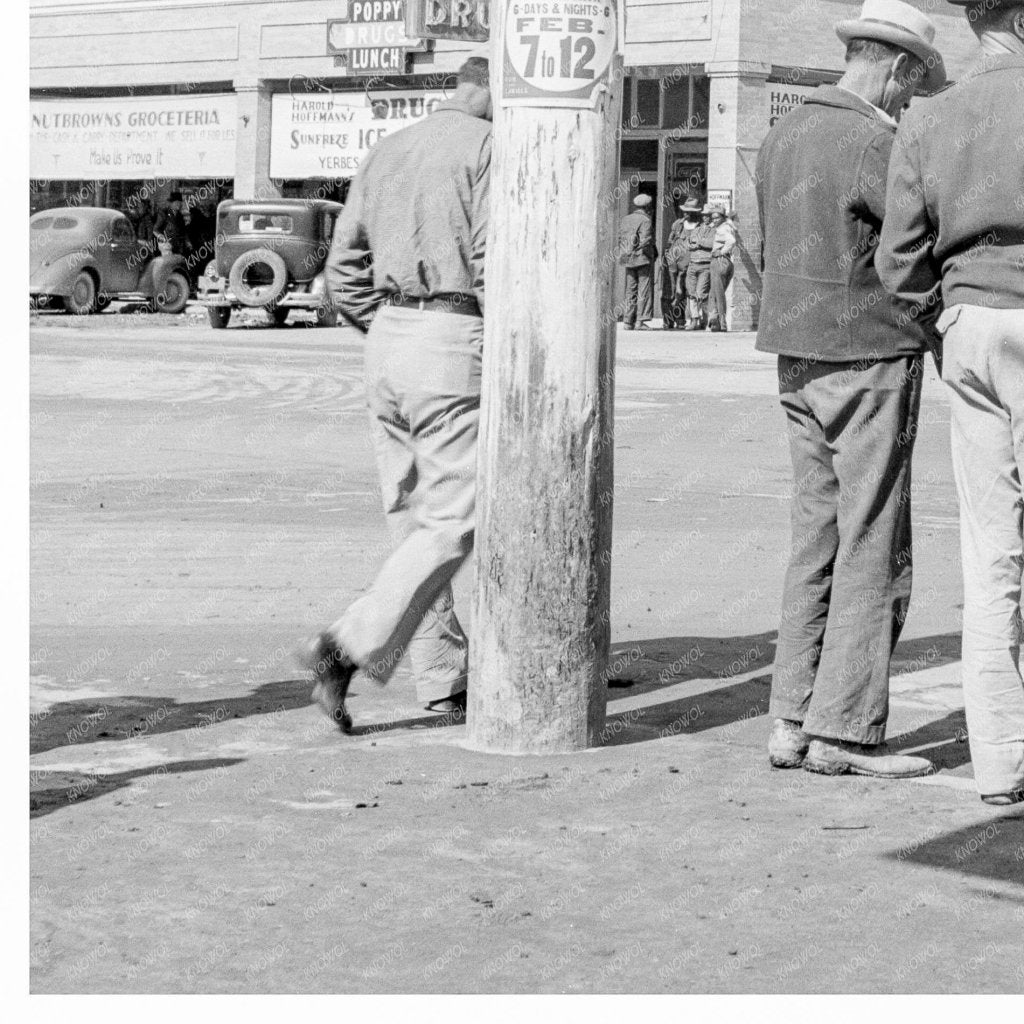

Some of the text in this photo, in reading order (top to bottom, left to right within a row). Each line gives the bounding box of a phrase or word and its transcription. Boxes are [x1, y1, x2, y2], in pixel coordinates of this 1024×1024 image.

[353, 0, 402, 22] POPPY
[552, 3, 560, 14] &
[352, 48, 400, 70] LUNCH
[520, 35, 596, 80] 7 to 12
[292, 100, 334, 111] HAROLD
[128, 110, 220, 128] GROCETERIA
[89, 148, 112, 166] Make
